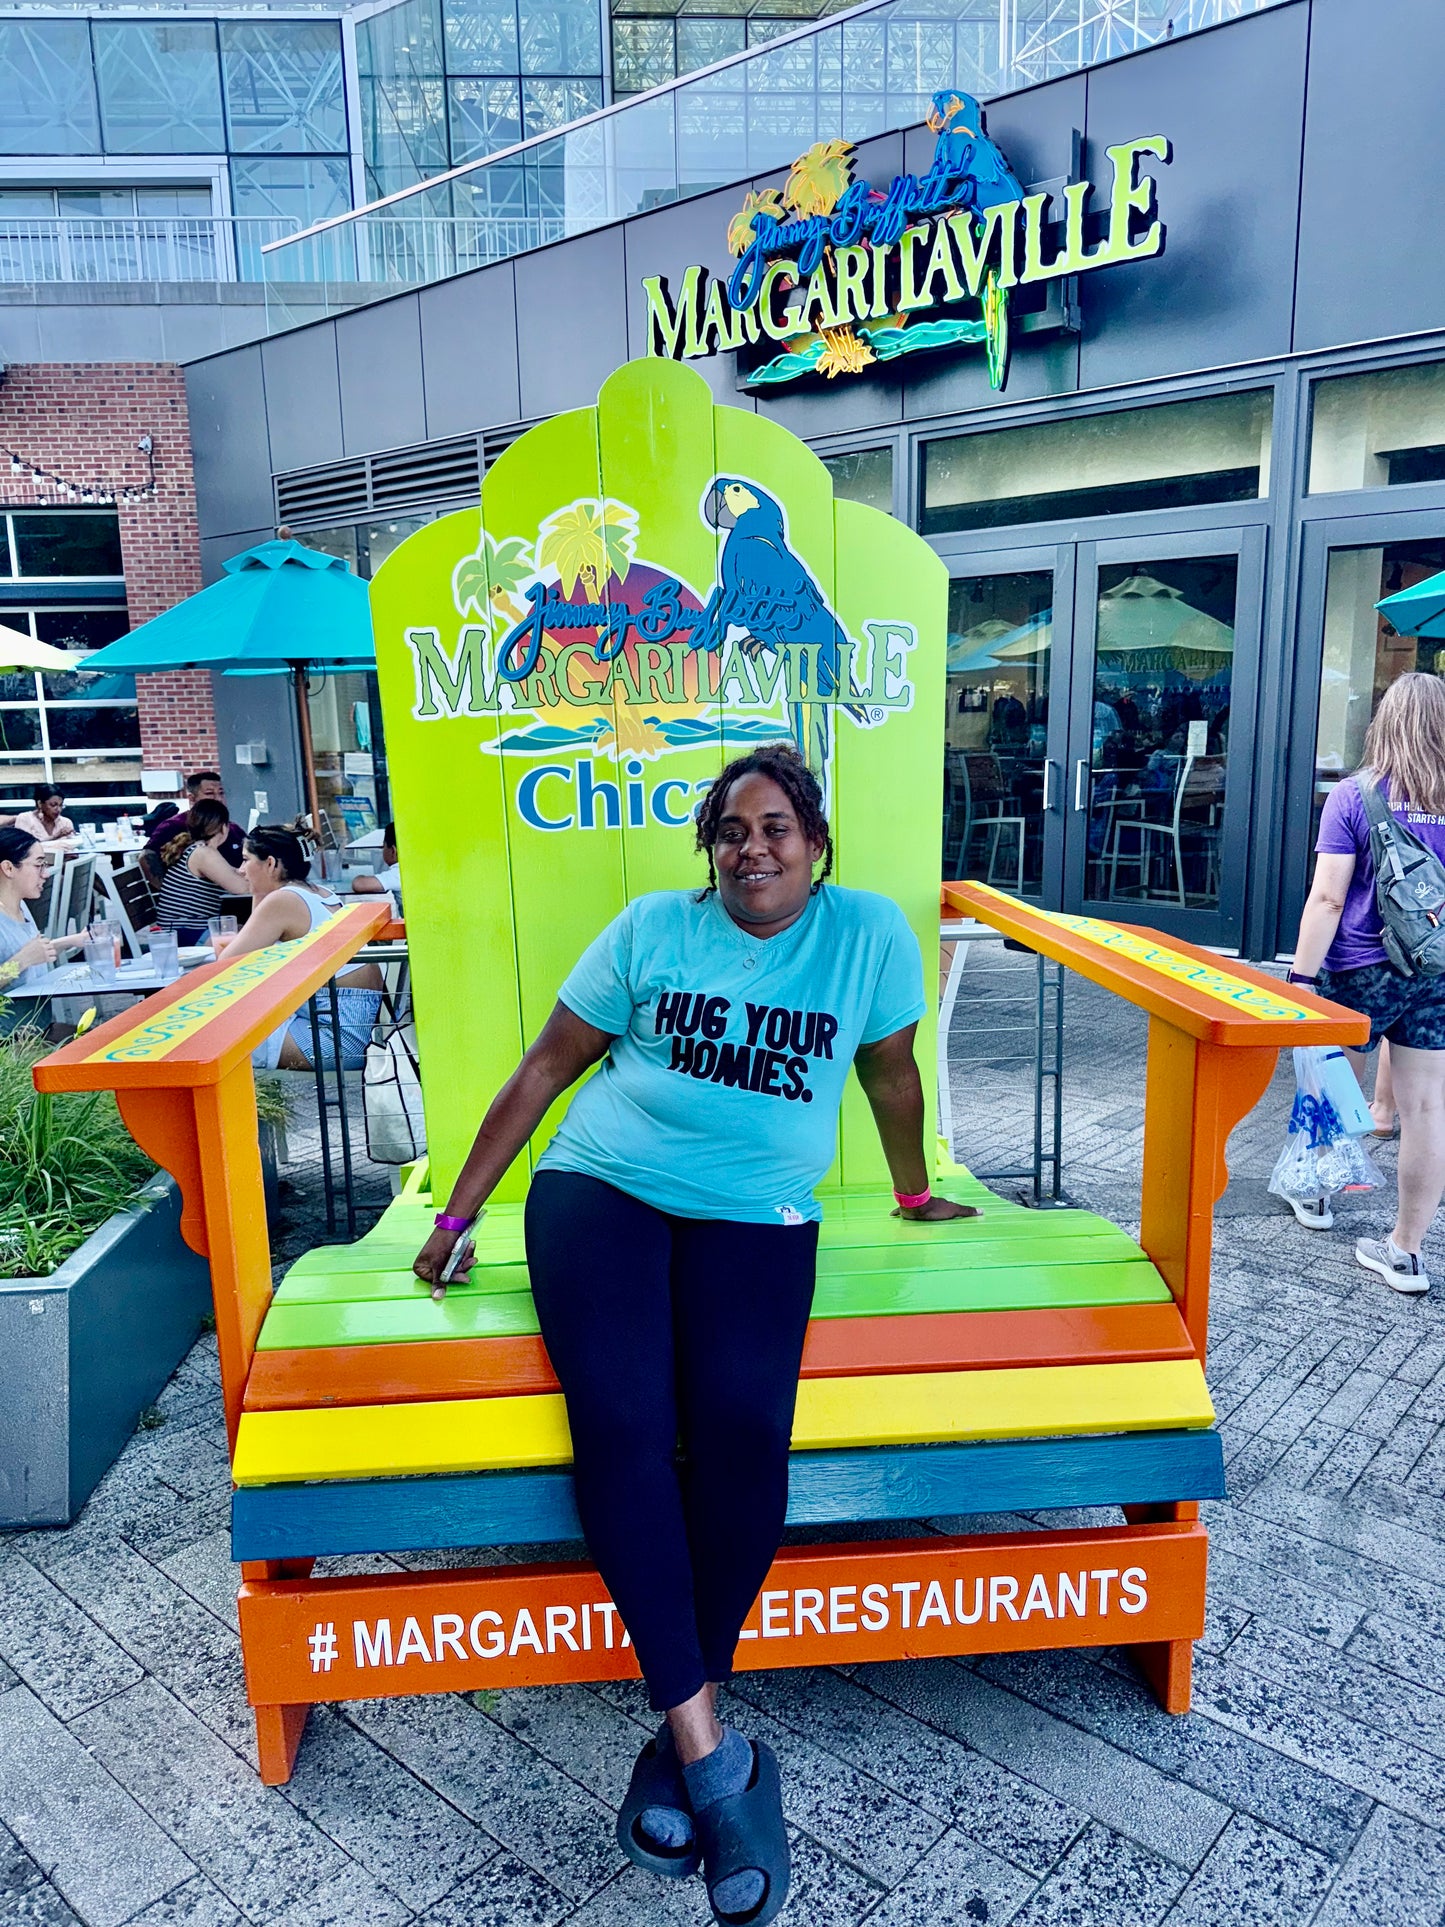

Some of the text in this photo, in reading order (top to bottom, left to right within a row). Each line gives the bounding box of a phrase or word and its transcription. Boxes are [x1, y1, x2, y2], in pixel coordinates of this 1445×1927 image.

[642, 135, 1169, 359] MARGARITAVILLE
[728, 211, 831, 311] Jimmy
[410, 624, 914, 716] MARGARITAVILLE
[499, 579, 806, 681] Jimmy Buffett's
[518, 760, 713, 828] Chic
[1407, 813, 1437, 824] STARTS
[654, 992, 838, 1060] HUG YOUR
[667, 1036, 813, 1103] HOMIES.
